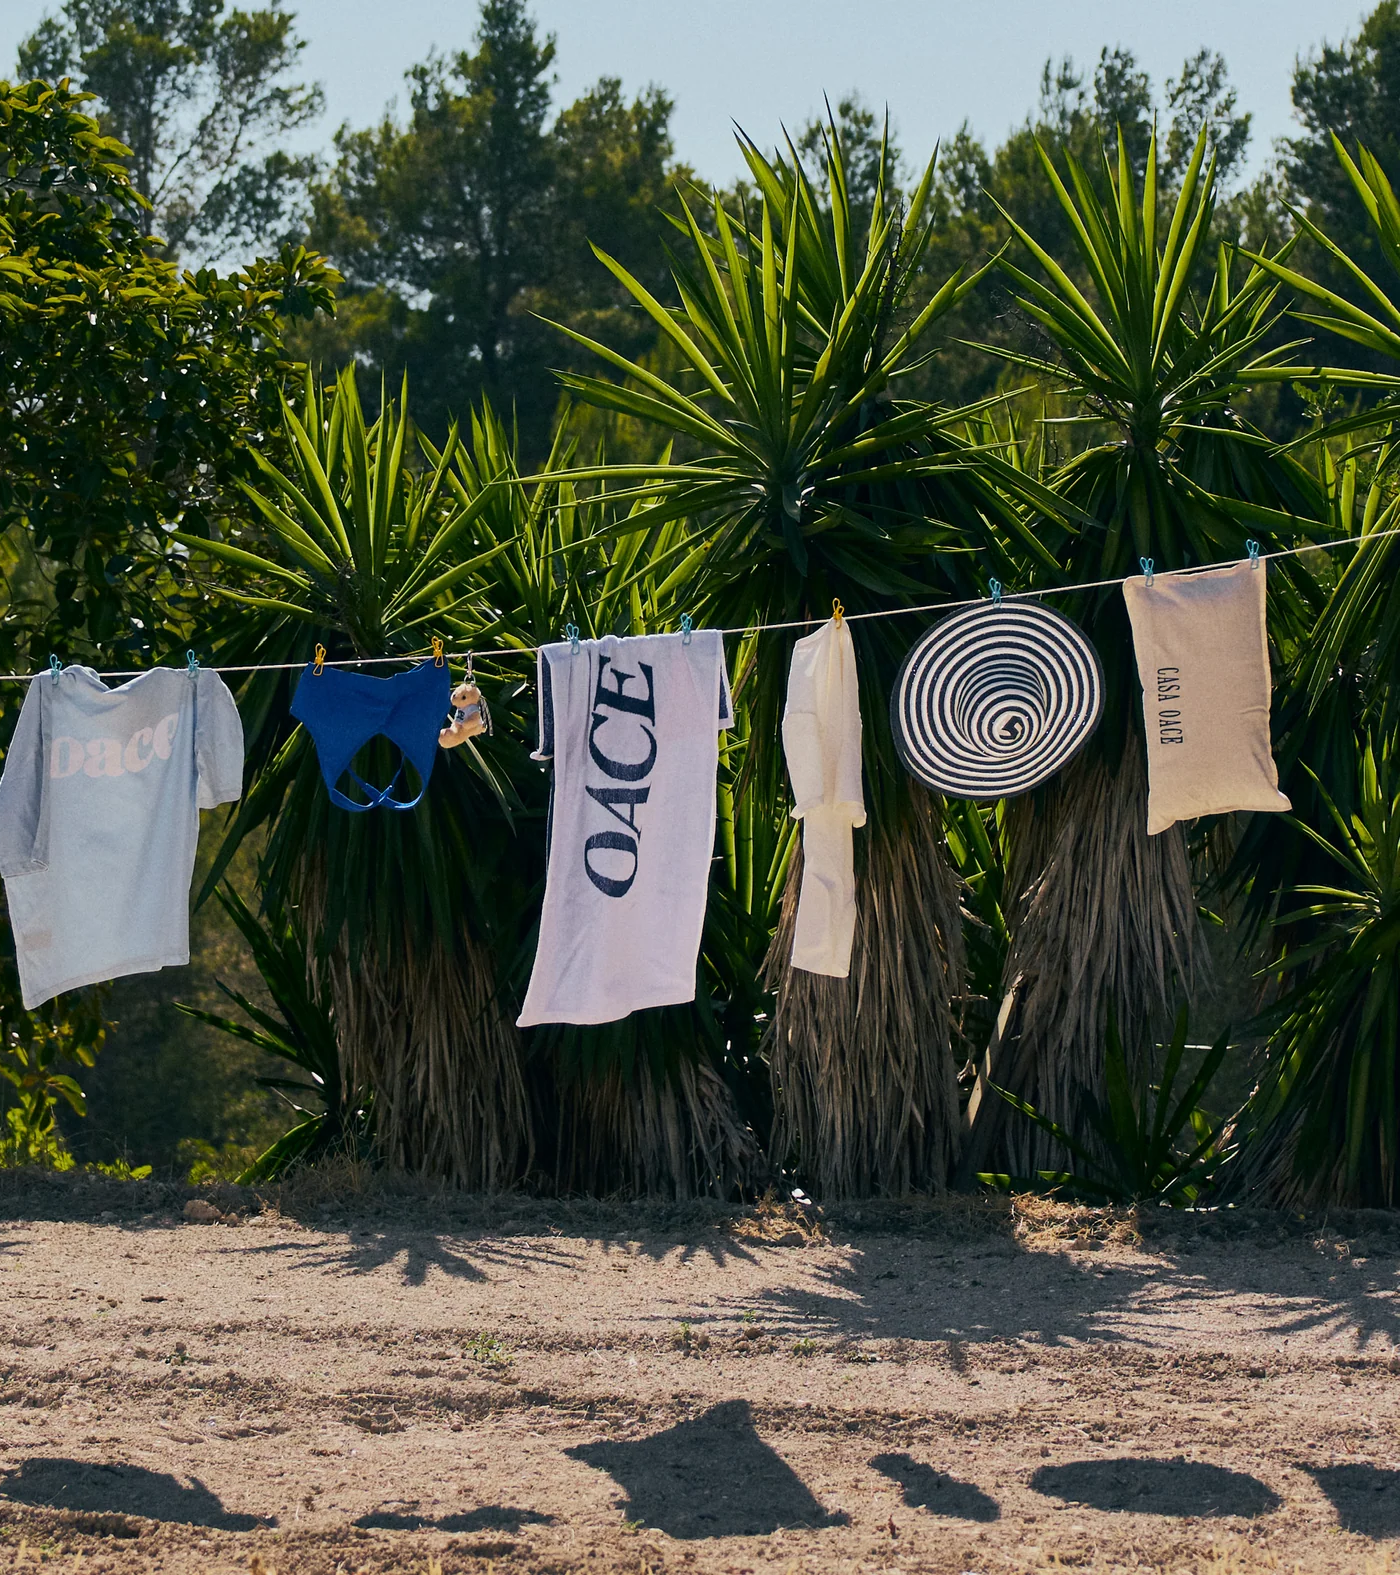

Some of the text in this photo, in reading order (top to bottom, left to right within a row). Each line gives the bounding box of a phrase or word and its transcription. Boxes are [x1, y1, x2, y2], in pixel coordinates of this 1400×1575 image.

[584, 654, 657, 898] OACE
[1157, 667, 1183, 744] CASA OACE
